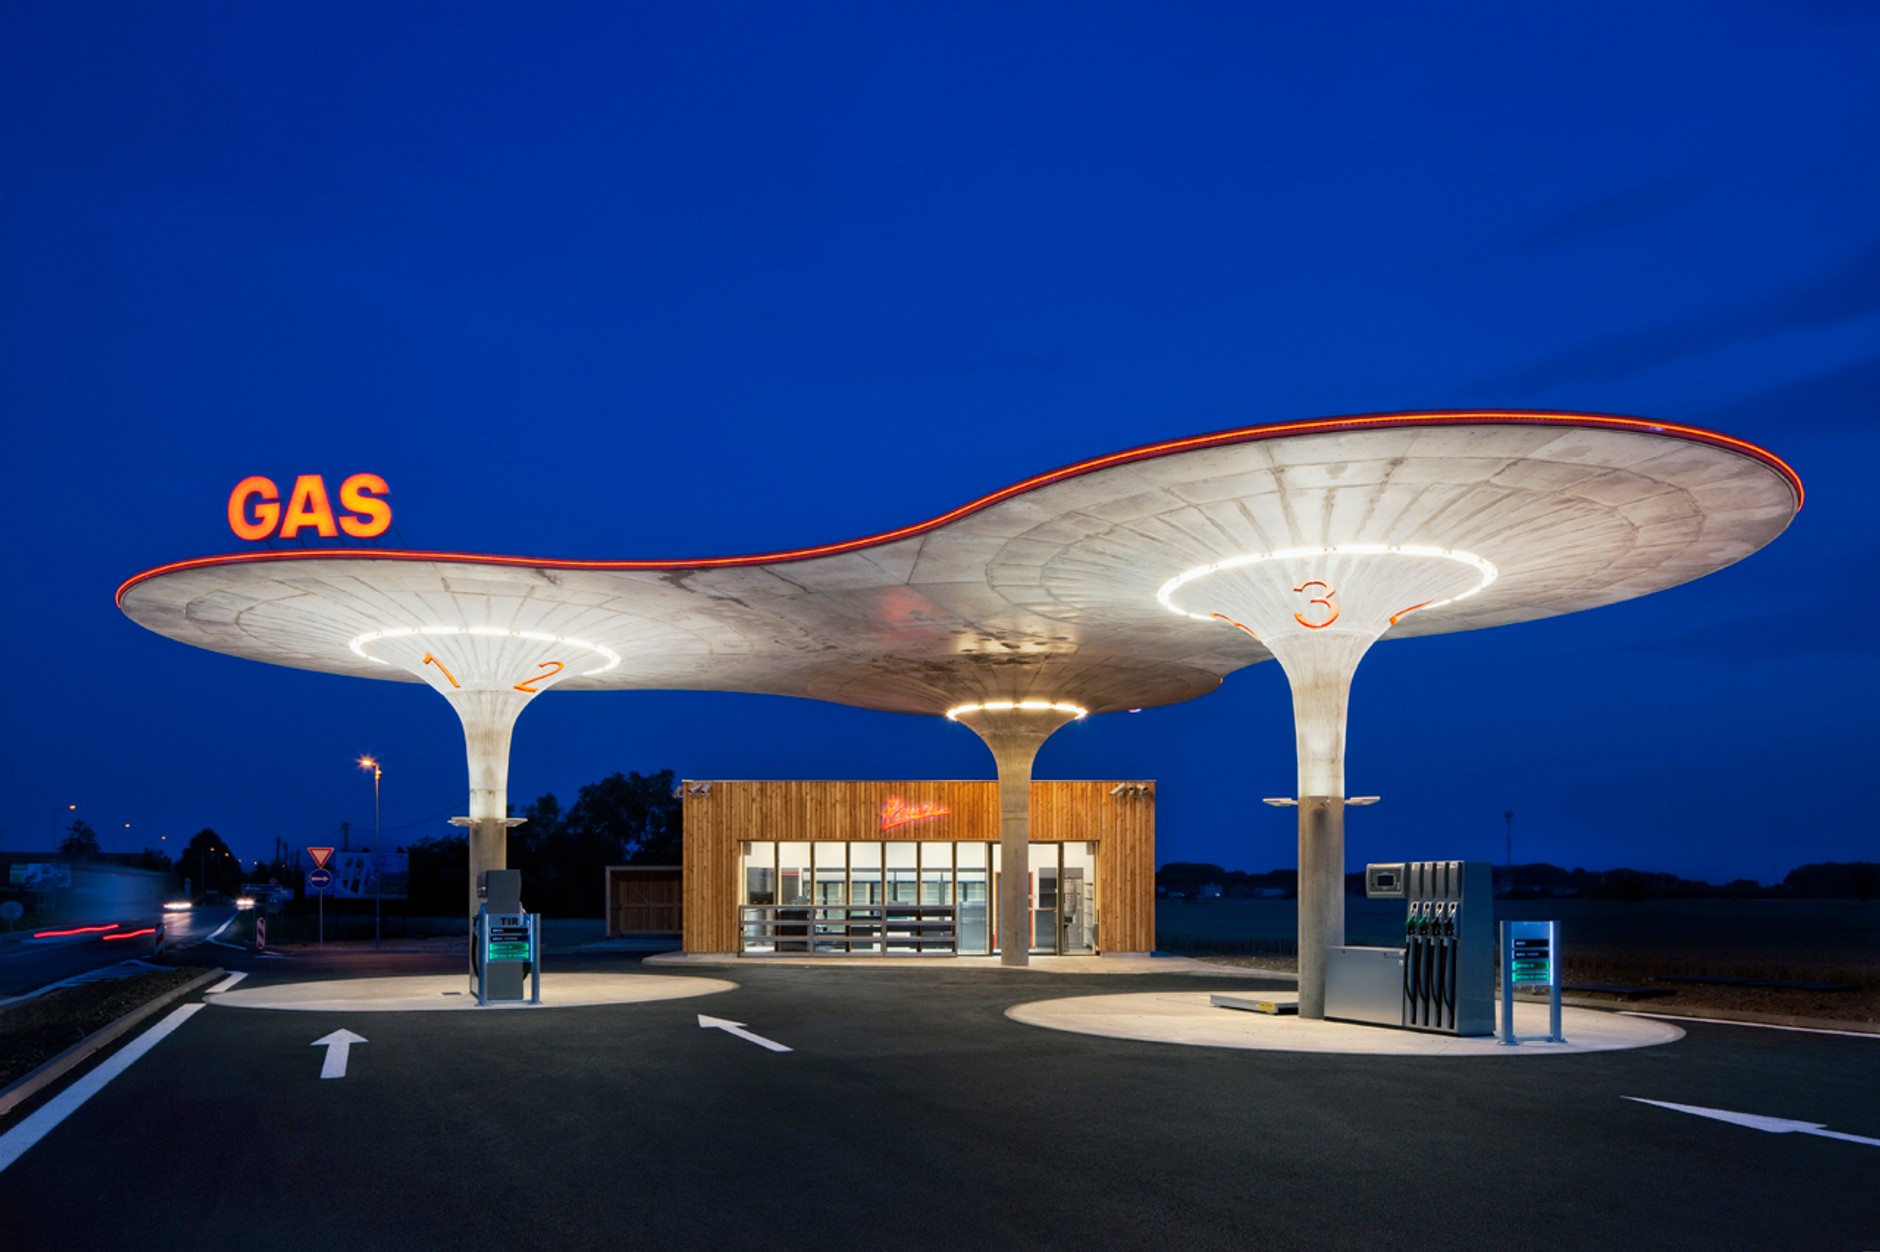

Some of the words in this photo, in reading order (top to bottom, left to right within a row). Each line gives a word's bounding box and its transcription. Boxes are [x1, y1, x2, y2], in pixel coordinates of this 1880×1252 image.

[228, 473, 392, 541] GAS
[1293, 580, 1341, 630] 3
[423, 652, 461, 689] 1
[513, 660, 566, 693] 2
[500, 917, 519, 926] TIR
